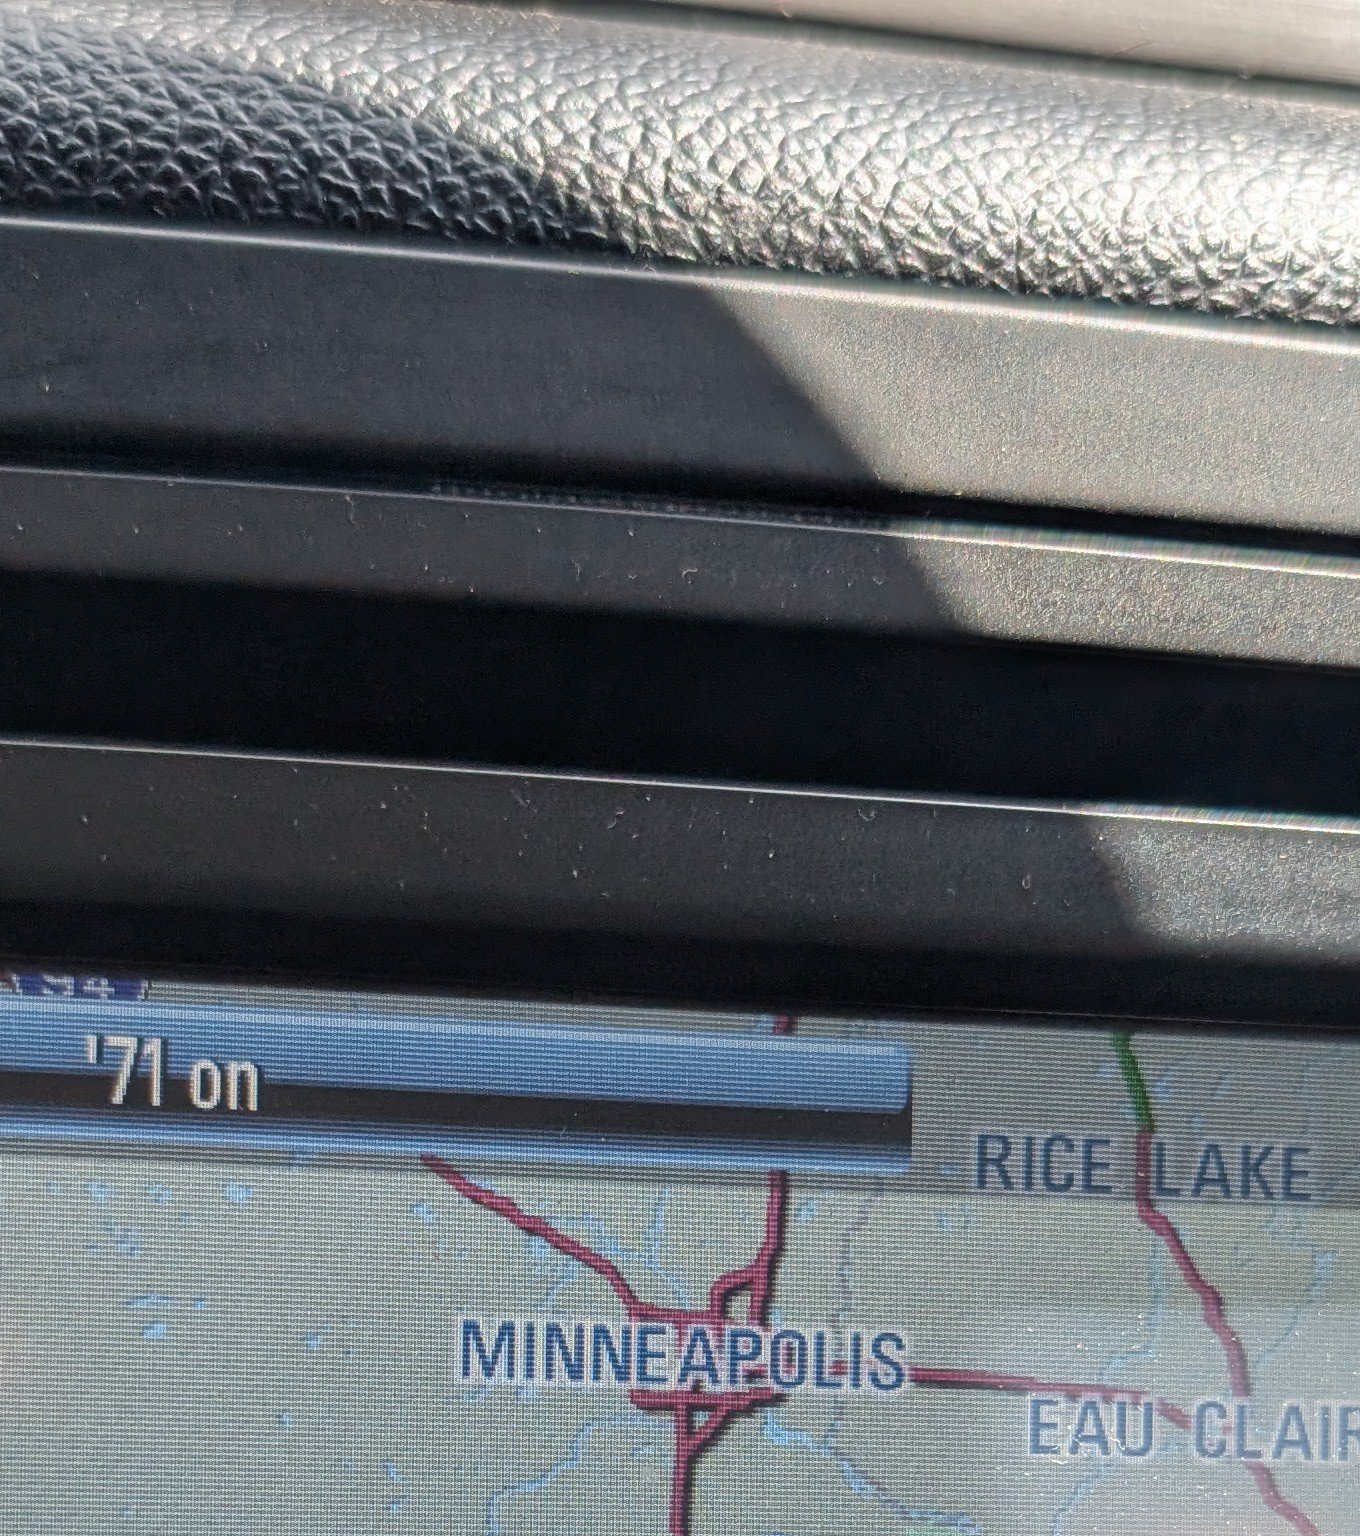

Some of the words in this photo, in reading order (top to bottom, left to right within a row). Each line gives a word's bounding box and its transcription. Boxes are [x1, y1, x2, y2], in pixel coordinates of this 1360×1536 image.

[189, 1060, 261, 1112] on
[976, 1134, 1111, 1193] RICE
[1155, 1144, 1313, 1199] LAKE
[461, 1319, 908, 1391] MINNEAPOLIS
[1028, 1401, 1152, 1457] EAU
